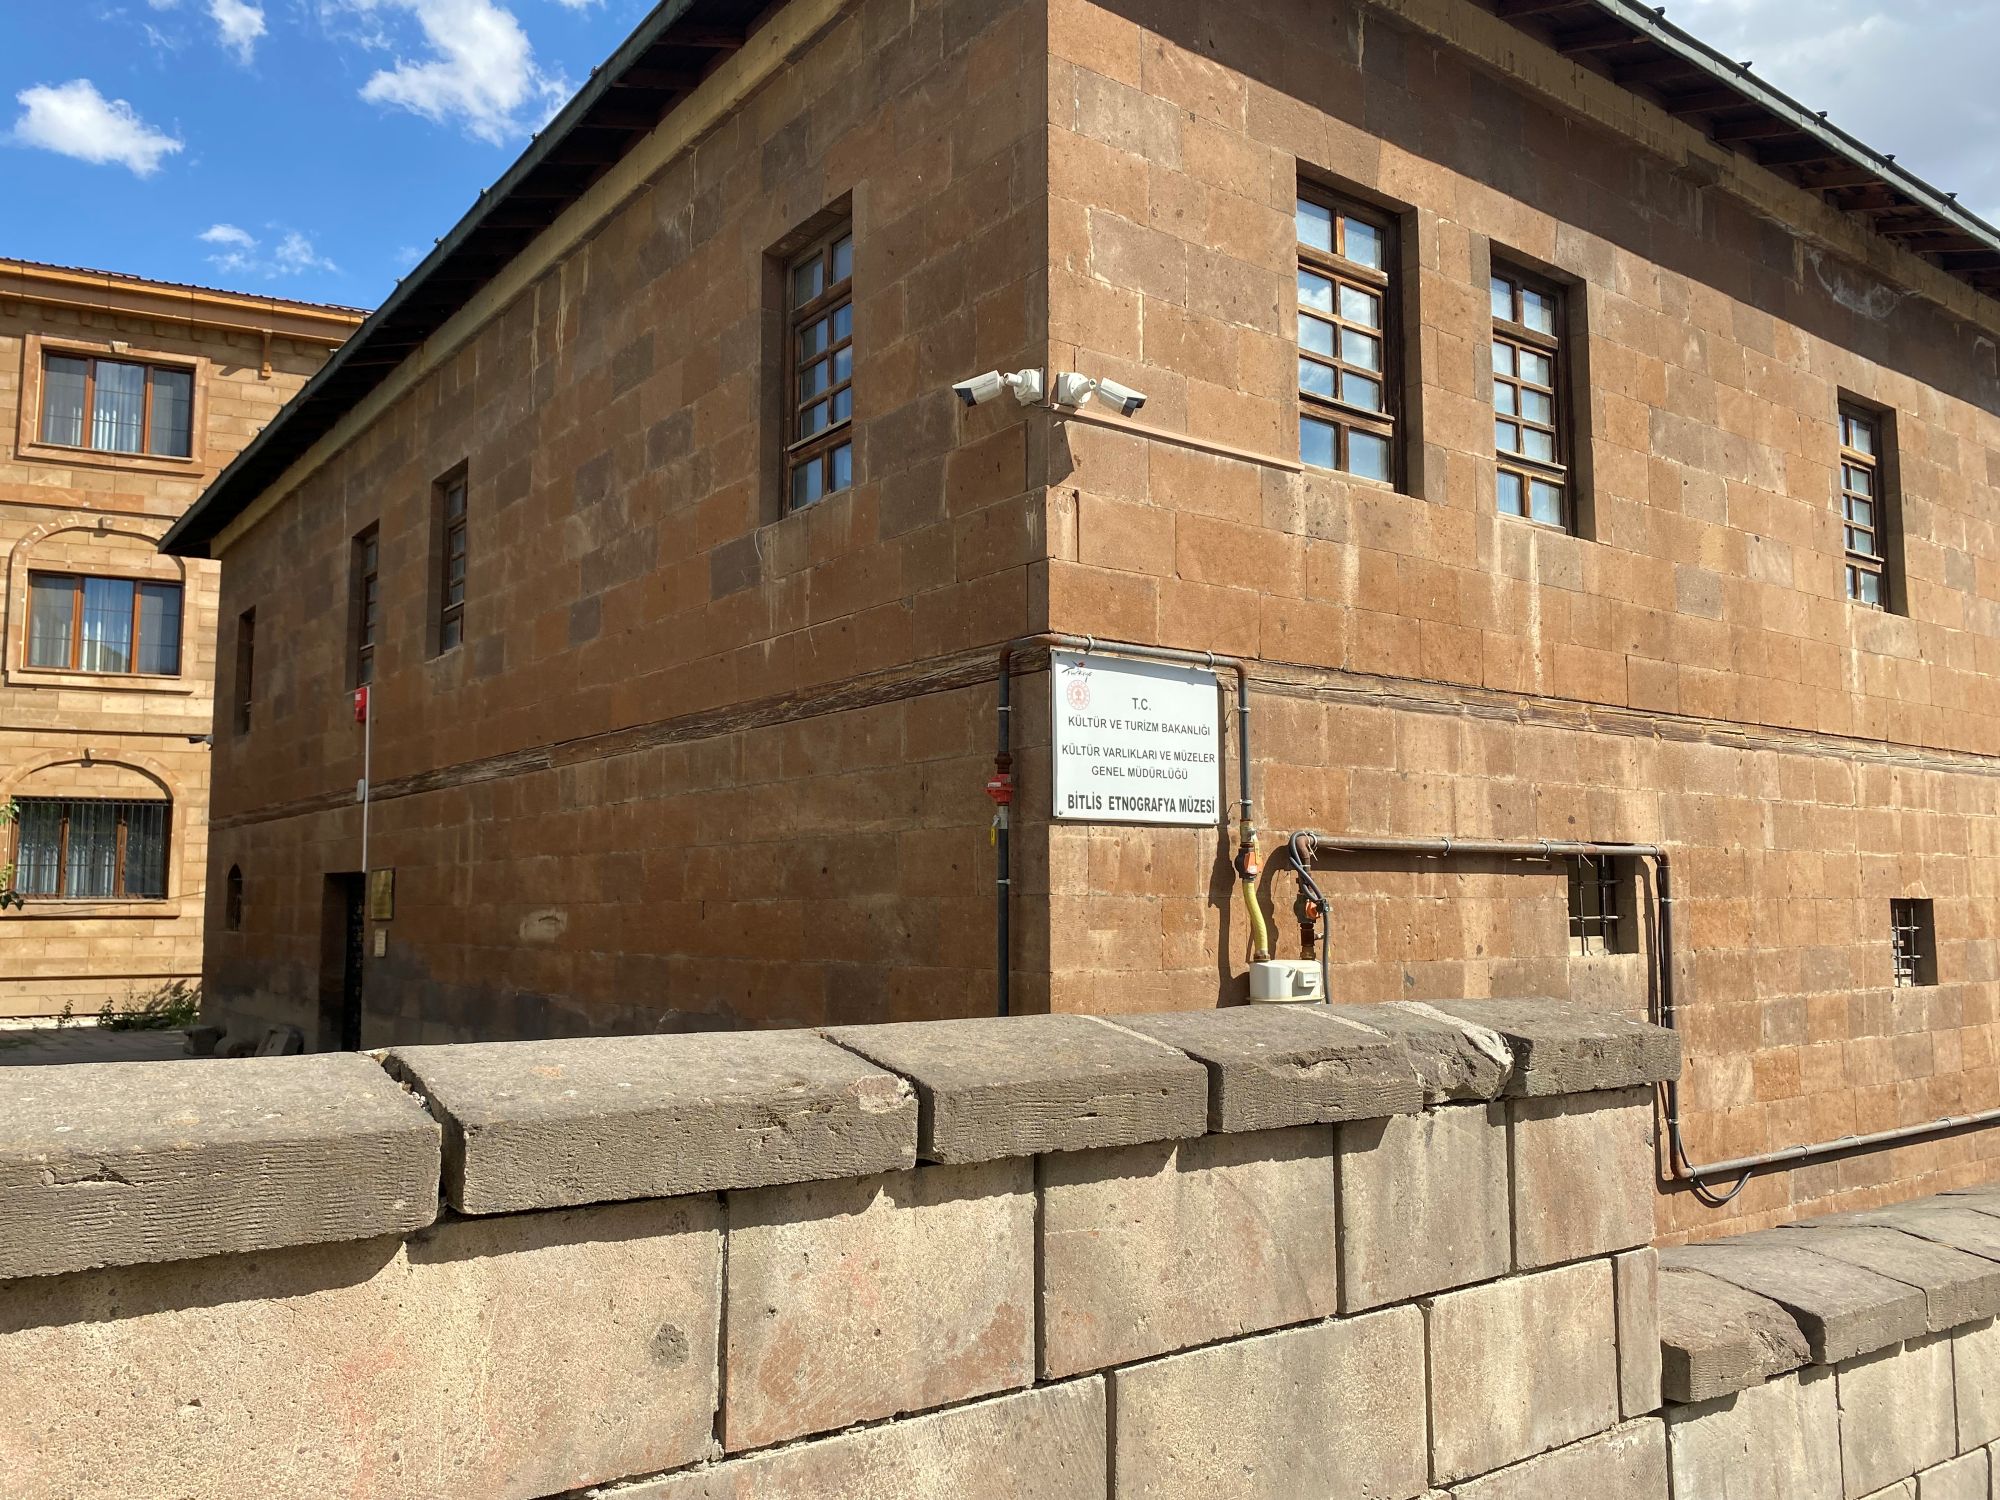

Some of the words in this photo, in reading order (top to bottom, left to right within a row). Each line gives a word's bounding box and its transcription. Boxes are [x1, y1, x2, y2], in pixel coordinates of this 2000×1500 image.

[1131, 697, 1152, 711] T.C.
[1068, 714, 1107, 729] KÜLTÜR
[1110, 718, 1122, 730] VE
[1125, 719, 1159, 732] TURİZM
[1161, 721, 1210, 736] BAKANLIĞI
[1062, 742, 1100, 757] KÜLTÜR
[1103, 747, 1157, 760] VARLIKLARI
[1160, 750, 1172, 761] VE
[1174, 749, 1215, 763] MÜZELER
[1091, 765, 1125, 777] GENEL
[1127, 766, 1188, 780] MÜDÜRLÜĞÜ
[1067, 790, 1102, 810] BİTLİS
[1109, 795, 1177, 813] ETNOGRAFYA
[1179, 795, 1215, 814] MÜZESİ
